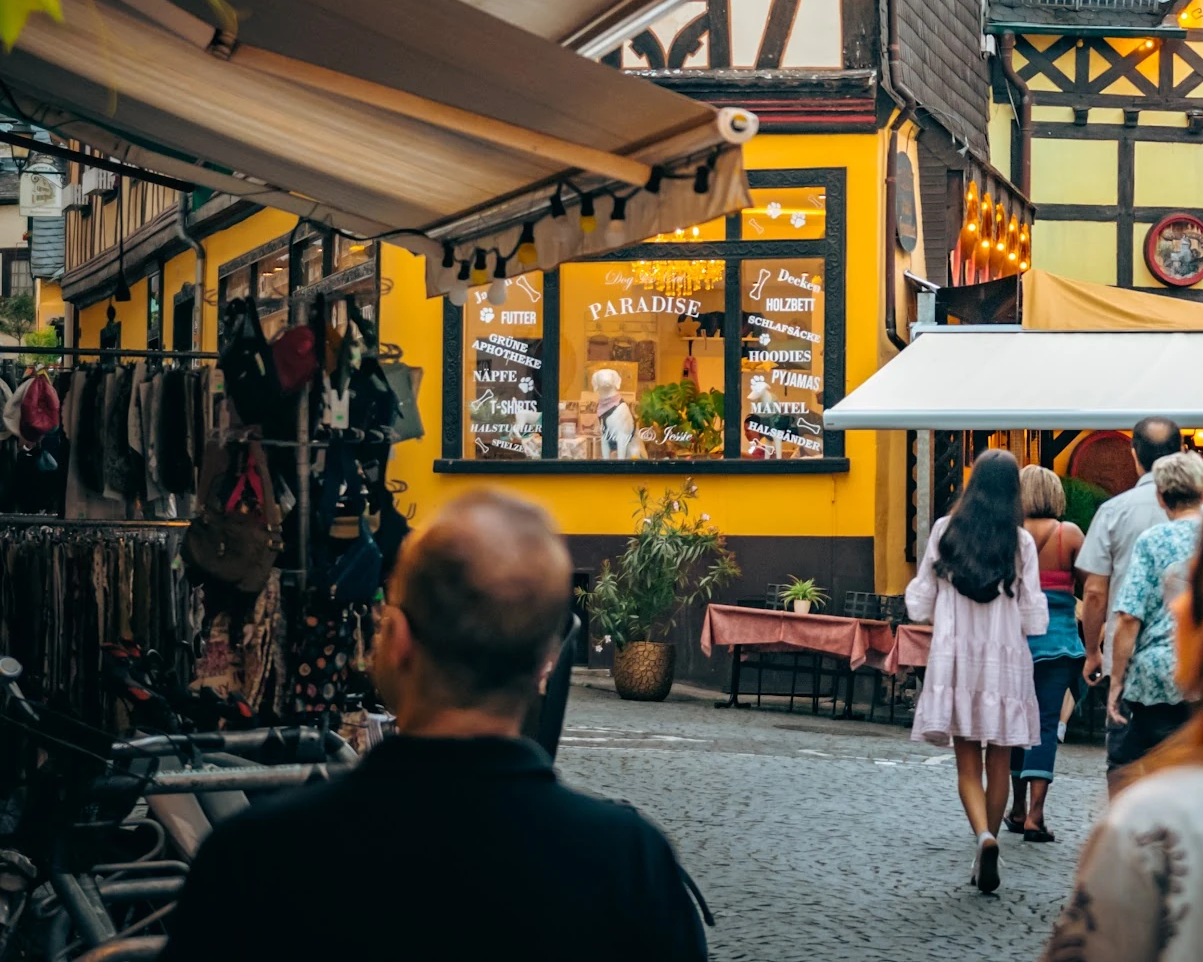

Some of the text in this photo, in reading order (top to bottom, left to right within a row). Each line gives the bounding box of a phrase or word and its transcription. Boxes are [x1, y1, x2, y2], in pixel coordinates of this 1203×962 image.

[777, 268, 822, 294] Decken
[588, 295, 702, 321] PARADISE
[765, 297, 817, 312] HOLZBETT
[500, 310, 537, 325] FUTTER
[747, 315, 822, 344] SCHLAFSÄCKE
[488, 332, 529, 354] GRÜNE
[471, 339, 542, 370] APHOTHEKE
[748, 350, 812, 363] HOODIES
[472, 367, 518, 383] NÄPFE
[771, 369, 821, 392] PYJAMAS
[750, 401, 810, 414] MANTEL
[747, 420, 822, 452] HALSBÄNDER
